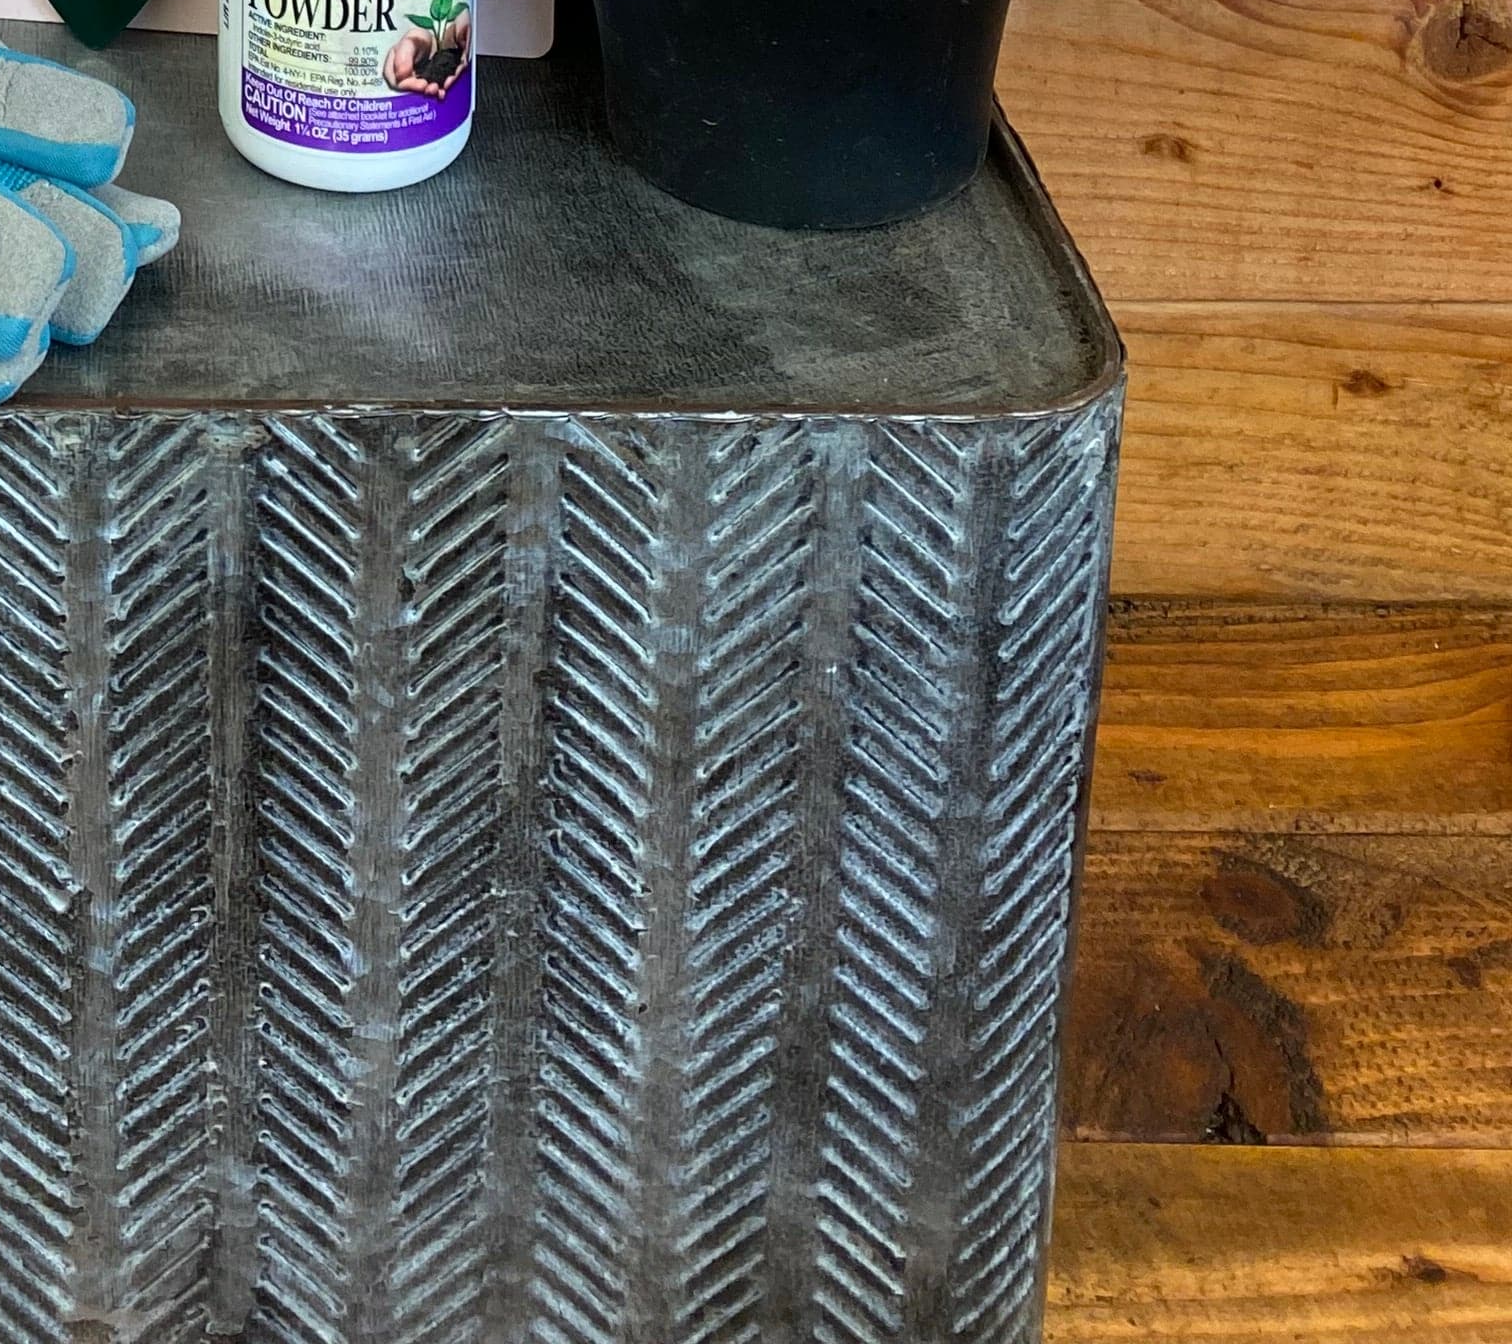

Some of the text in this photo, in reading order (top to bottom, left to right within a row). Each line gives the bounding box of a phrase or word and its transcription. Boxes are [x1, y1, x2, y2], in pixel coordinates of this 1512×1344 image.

[248, 31, 271, 48] OTHER
[272, 42, 332, 63] INGREDIENTS:
[248, 40, 269, 58] TOTAL
[245, 71, 392, 112] Keep Out Of Reach Of Children
[310, 73, 326, 84] EPA
[244, 83, 306, 123] CAUTION
[246, 101, 259, 118] Net
[259, 109, 291, 131] Weight
[332, 129, 350, 144] (35
[350, 129, 388, 145] grams)
